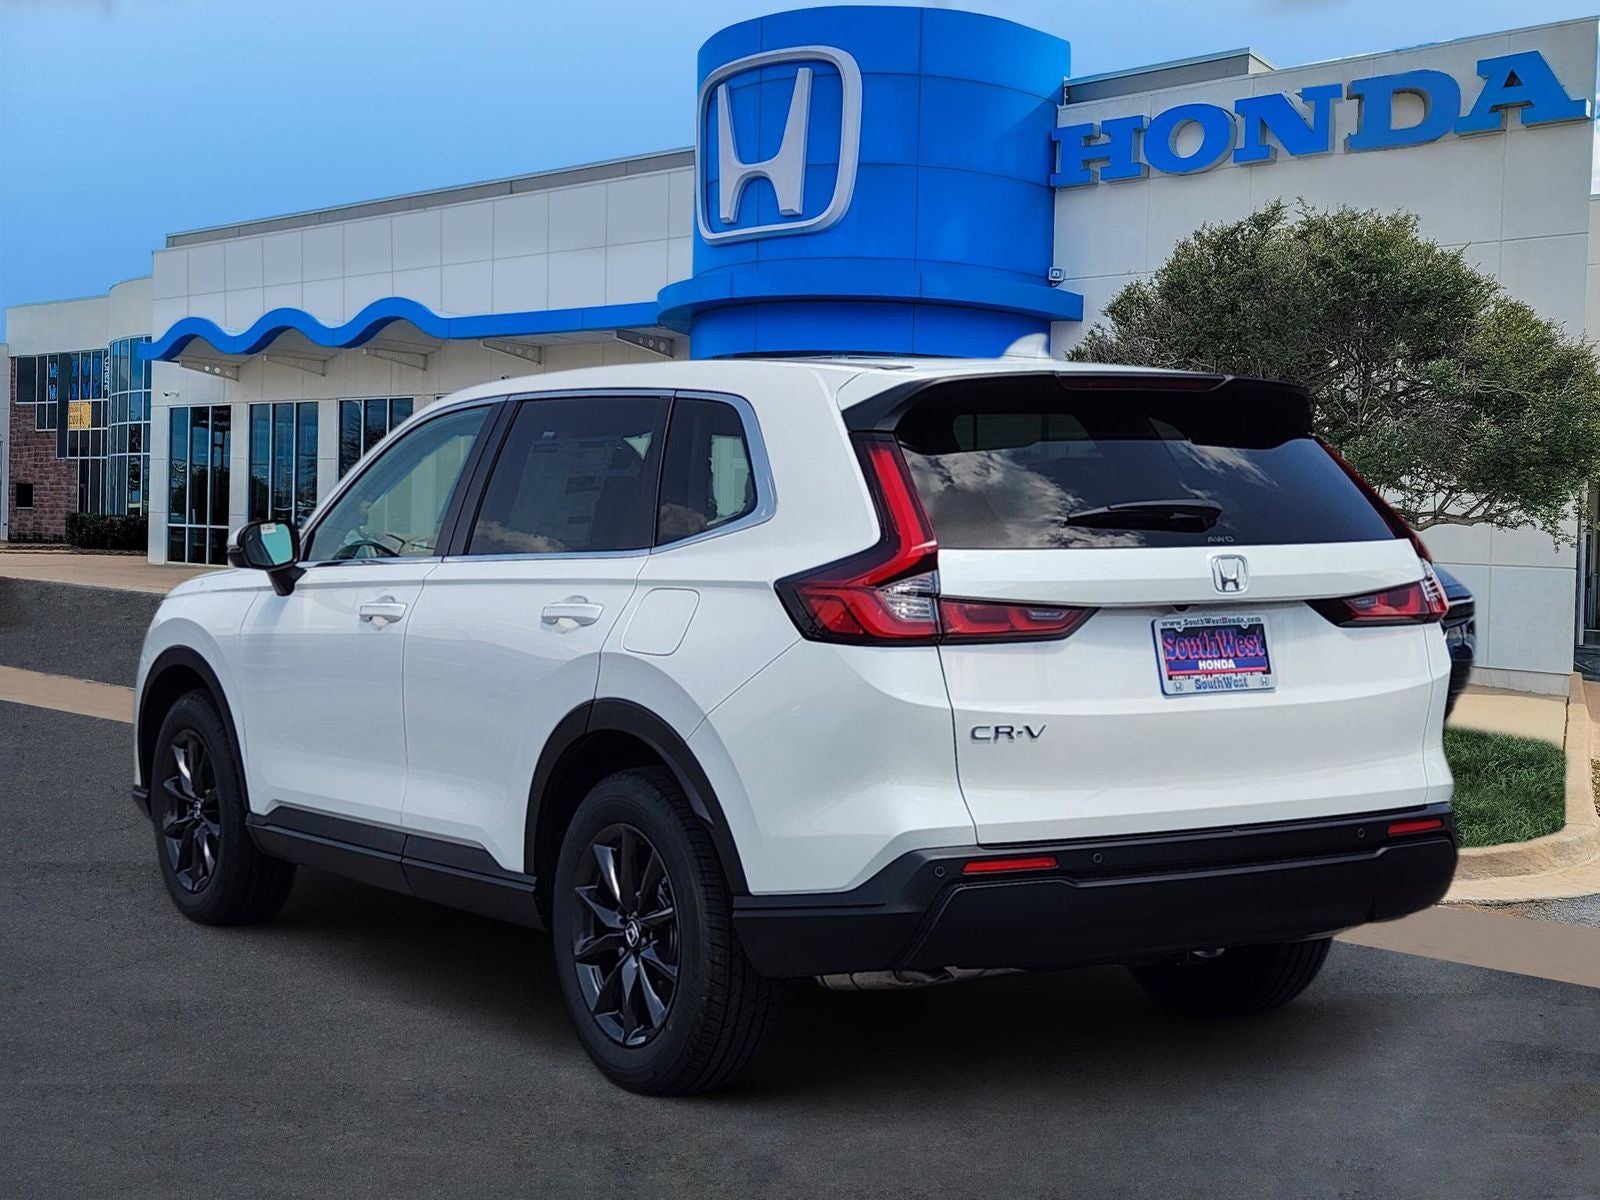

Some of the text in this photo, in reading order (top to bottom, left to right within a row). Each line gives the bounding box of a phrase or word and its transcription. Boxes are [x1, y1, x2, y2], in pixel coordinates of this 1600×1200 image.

[1050, 50, 1592, 189] HONDA
[1207, 535, 1235, 544] AWD
[1198, 659, 1236, 670] HONDA
[970, 724, 1046, 742] CR-V
